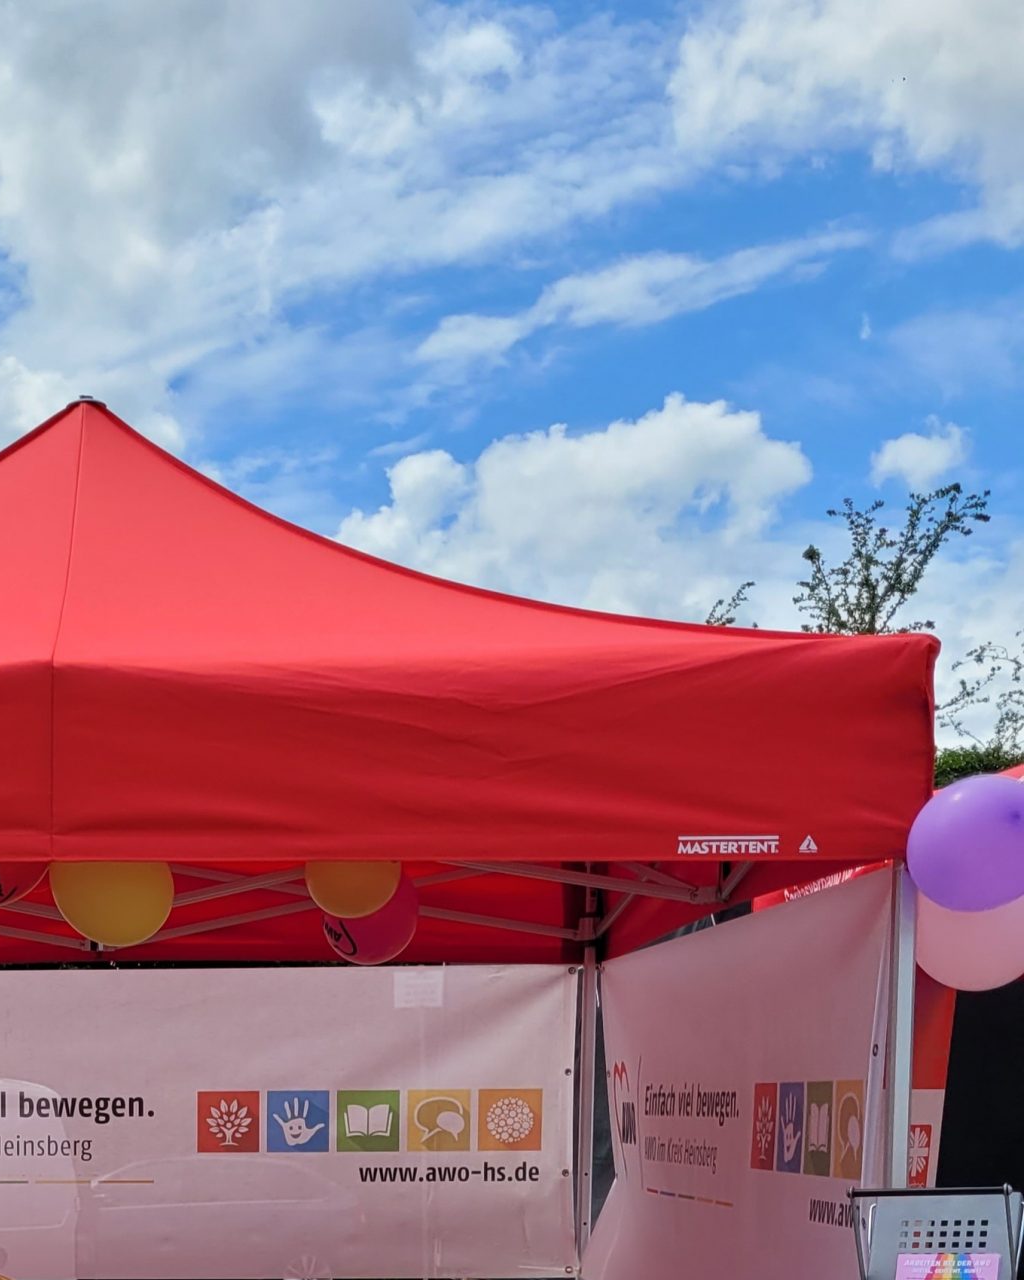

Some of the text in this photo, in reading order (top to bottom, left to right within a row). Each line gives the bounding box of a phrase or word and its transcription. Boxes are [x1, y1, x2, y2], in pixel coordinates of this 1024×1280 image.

[678, 841, 779, 854] MASTERTENT
[19, 1092, 155, 1124] bewegen.
[645, 1082, 739, 1127] Einfach viel bewegen.
[359, 1161, 539, 1182] www.awo-hs.de
[667, 1138, 683, 1164] Kreis
[684, 1139, 717, 1174] Heinsberg
